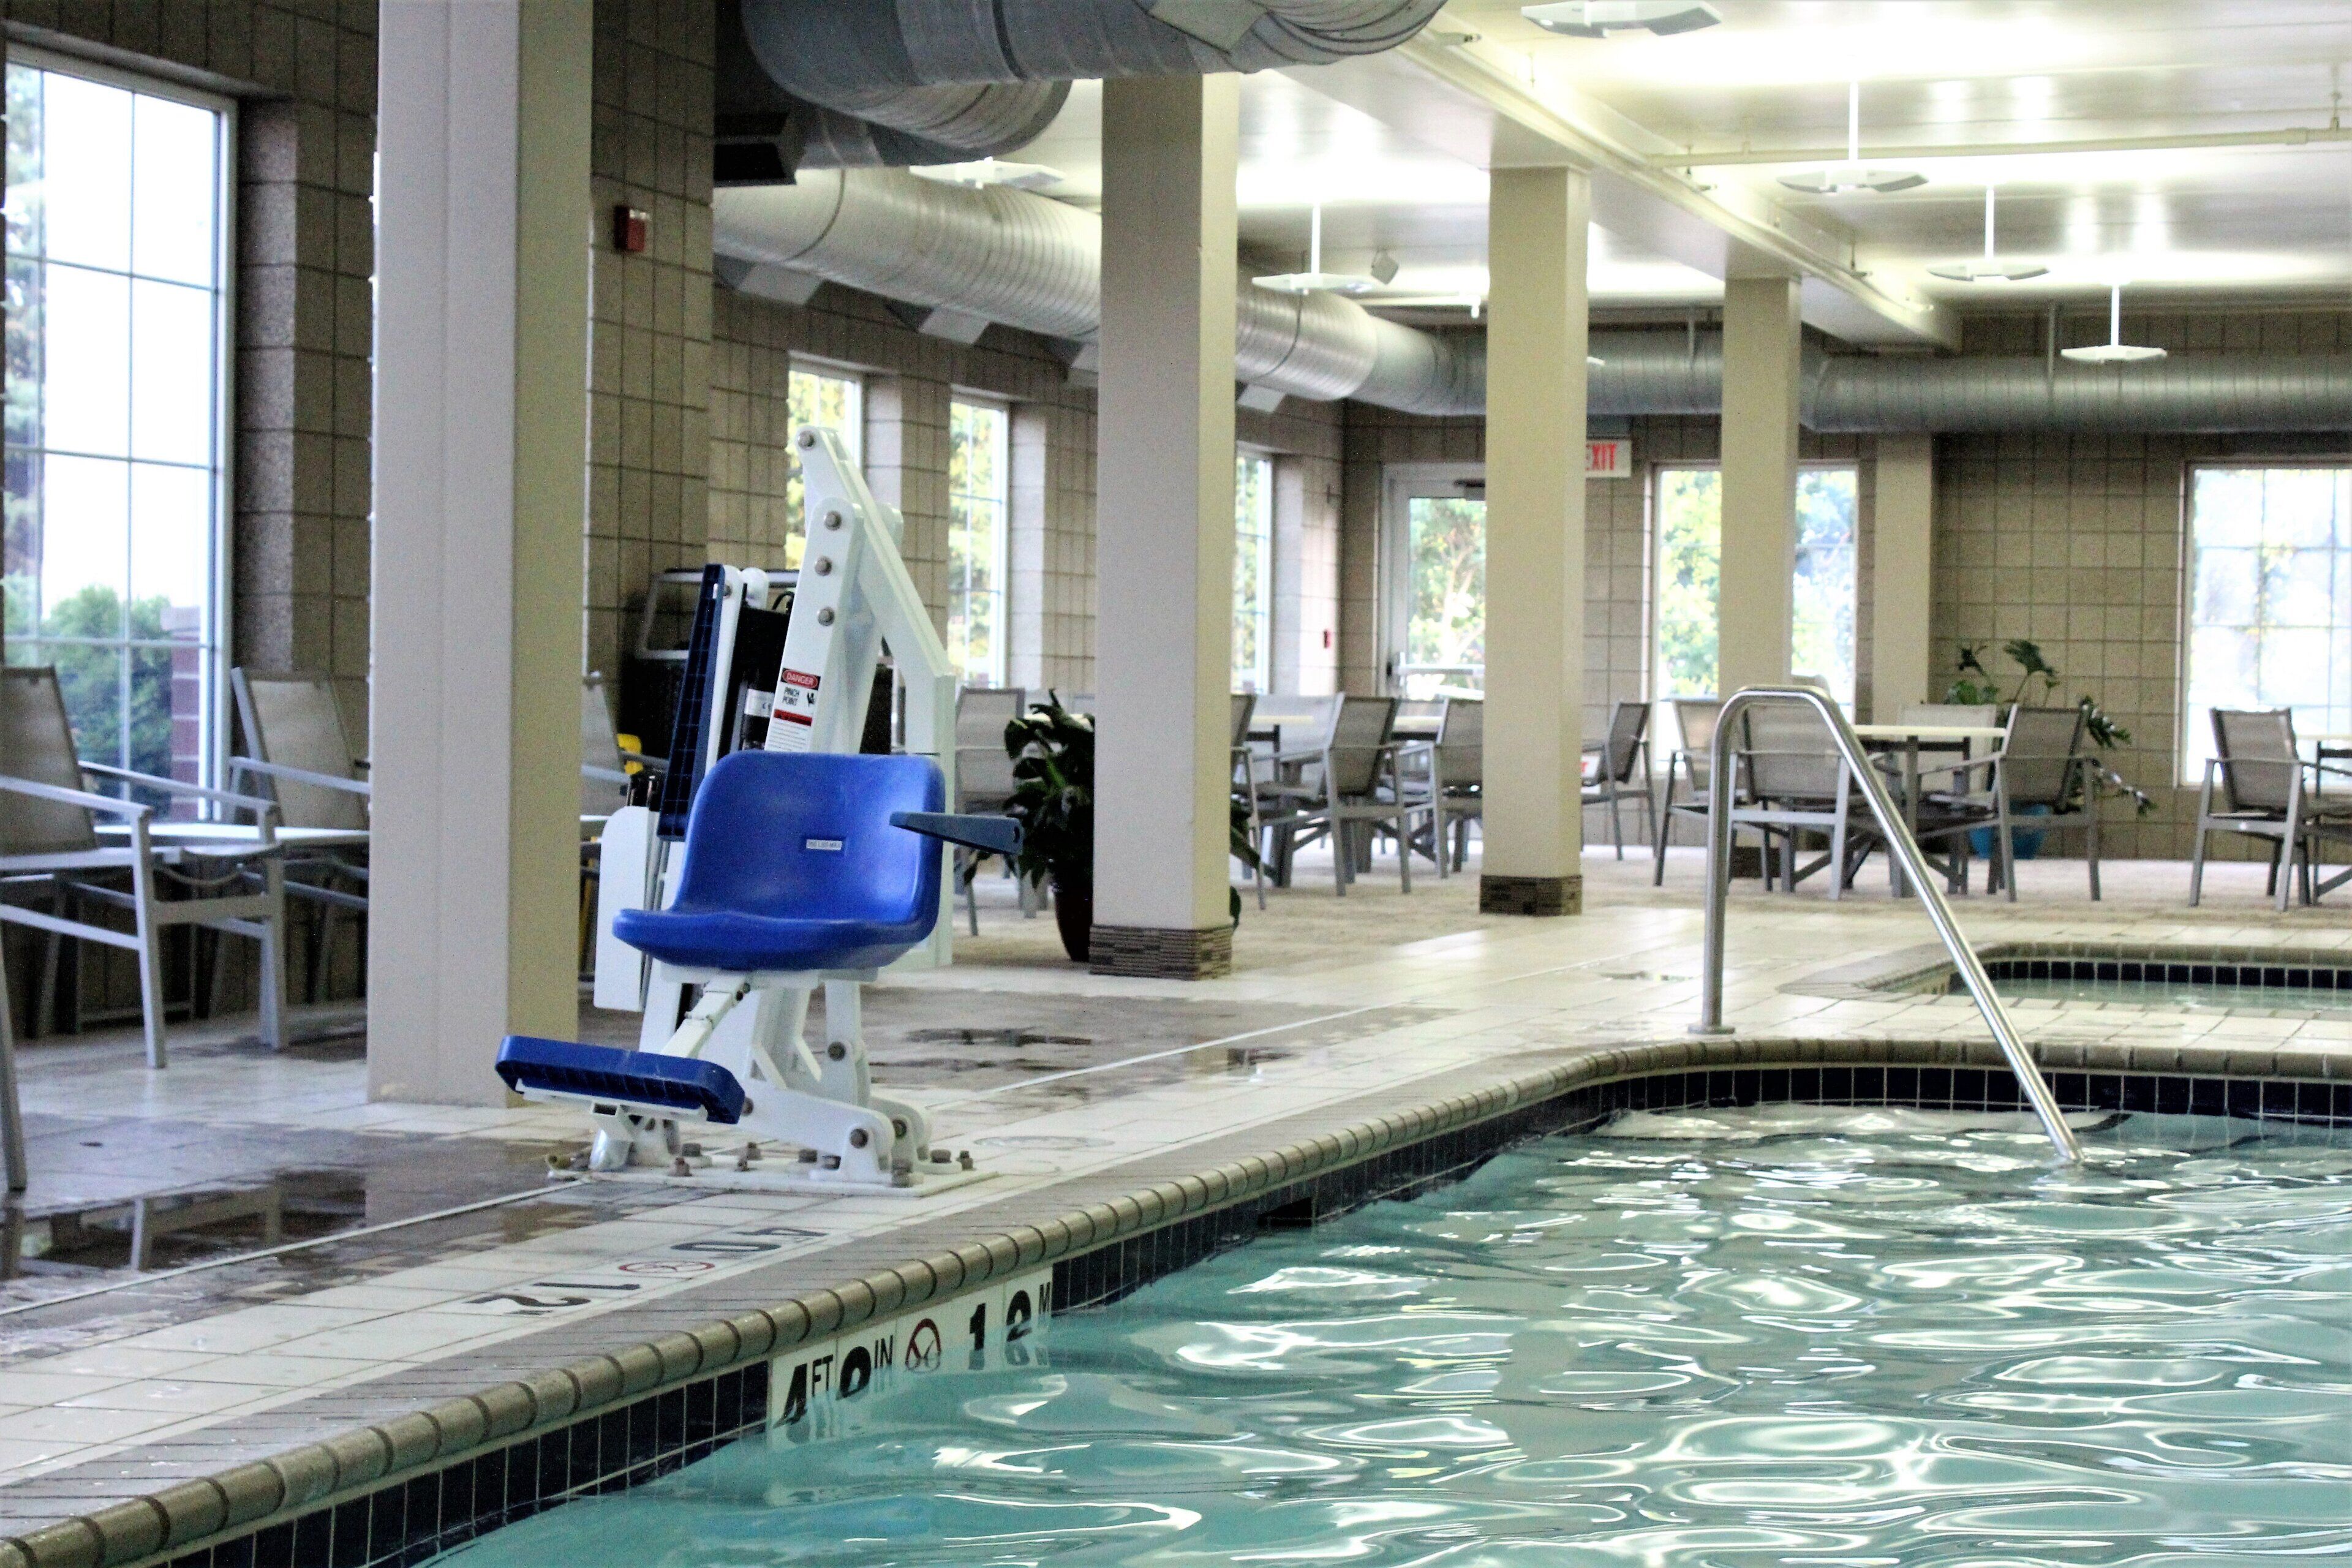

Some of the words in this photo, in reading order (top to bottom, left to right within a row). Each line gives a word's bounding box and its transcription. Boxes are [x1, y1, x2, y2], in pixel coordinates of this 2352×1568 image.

[786, 673, 814, 686] DANGER
[783, 687, 800, 697] PINCH
[782, 695, 798, 706] POINT
[812, 1354, 834, 1397] FT
[874, 1335, 894, 1369] IN
